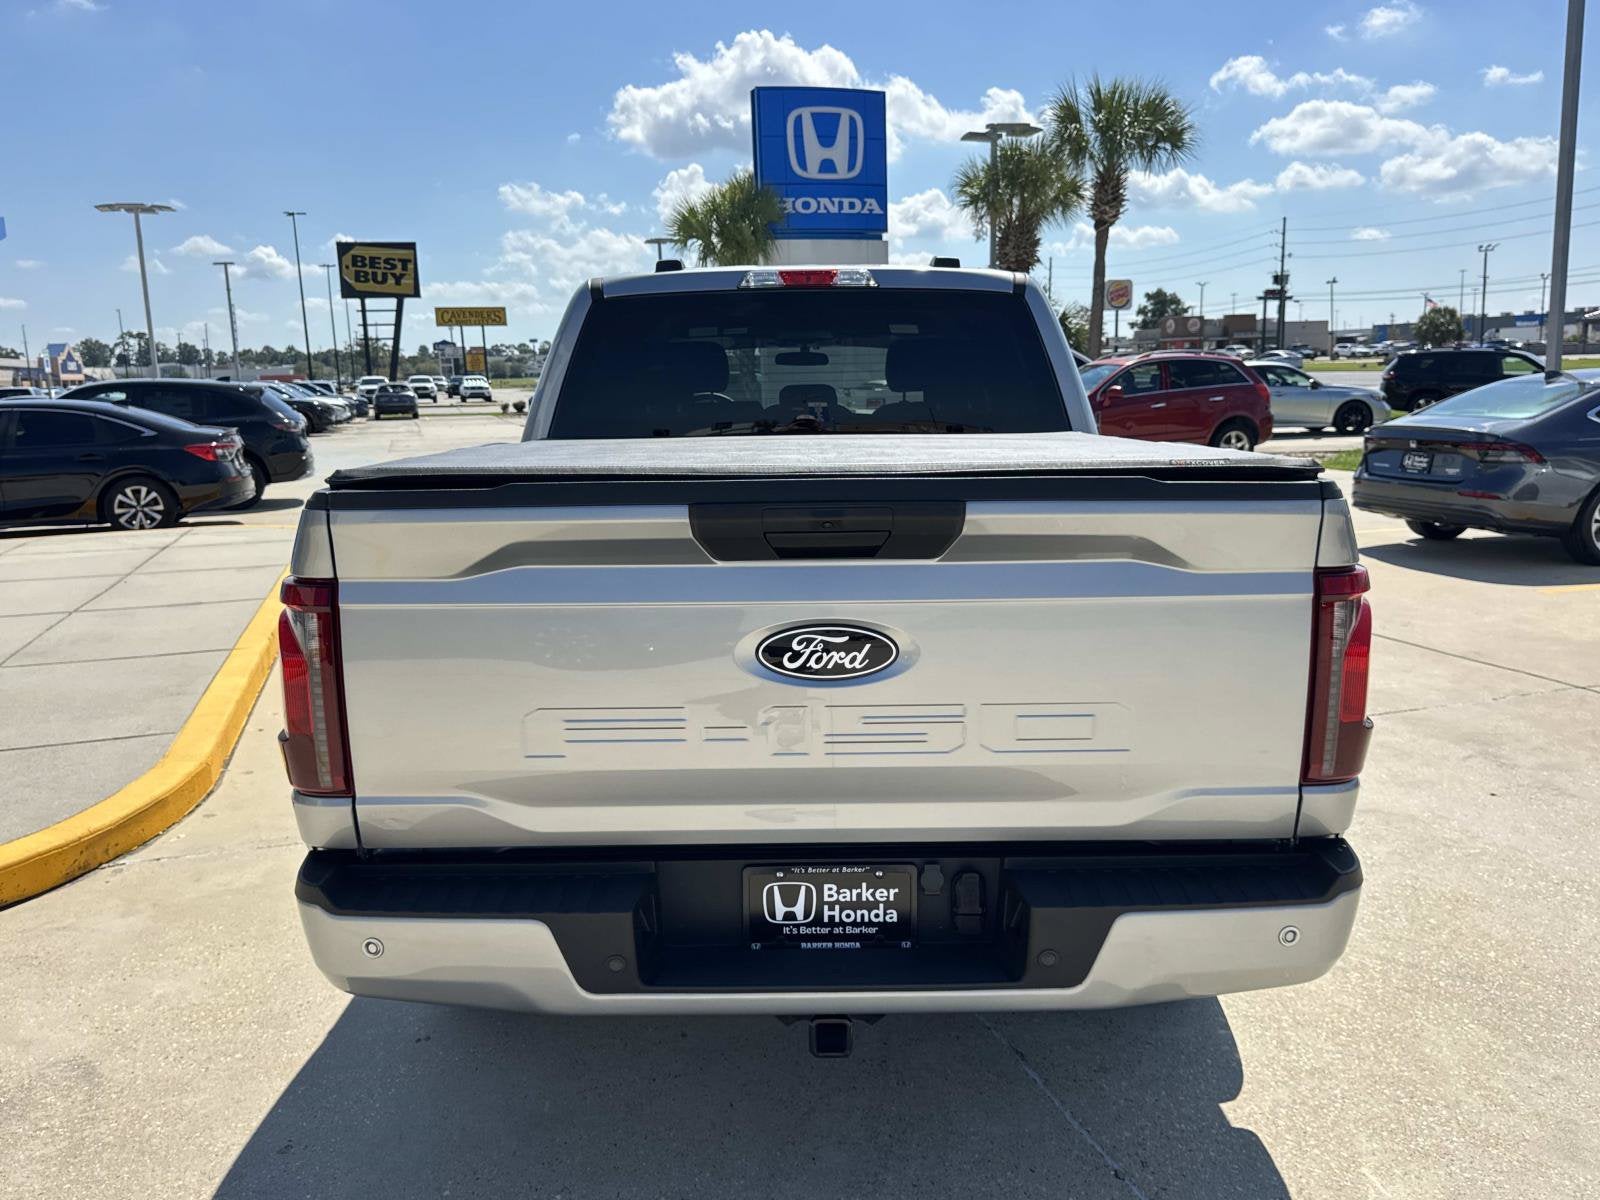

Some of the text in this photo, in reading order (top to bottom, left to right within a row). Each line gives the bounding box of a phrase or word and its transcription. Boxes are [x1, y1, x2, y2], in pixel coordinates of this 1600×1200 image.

[351, 254, 412, 272] BEST
[354, 269, 408, 286] BUY
[783, 634, 872, 669] Ford
[823, 882, 899, 902] Barker
[823, 904, 898, 923] Honda
[783, 925, 879, 935] It's Better at Barker
